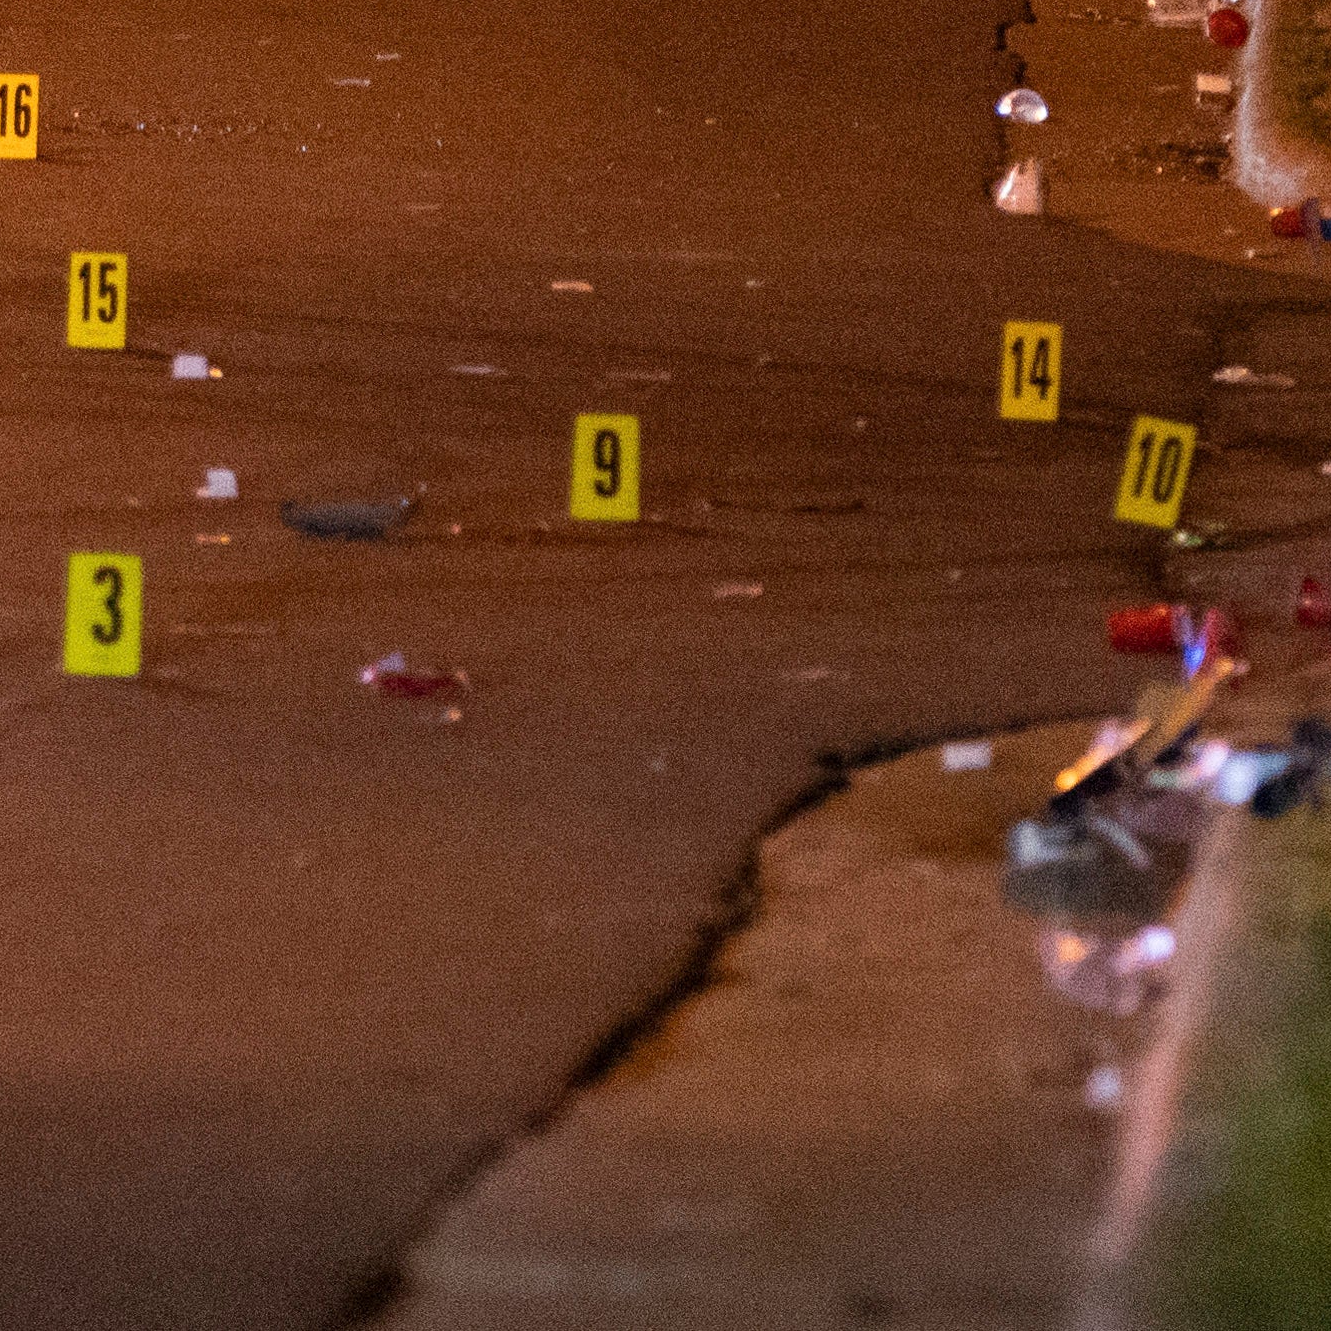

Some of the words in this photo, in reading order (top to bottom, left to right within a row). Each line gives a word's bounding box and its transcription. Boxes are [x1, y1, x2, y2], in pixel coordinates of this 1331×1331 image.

[79, 261, 118, 323] 15
[1010, 336, 1052, 401] 14
[593, 429, 622, 499] 9
[1134, 431, 1177, 505] 10
[92, 564, 124, 646] 3
